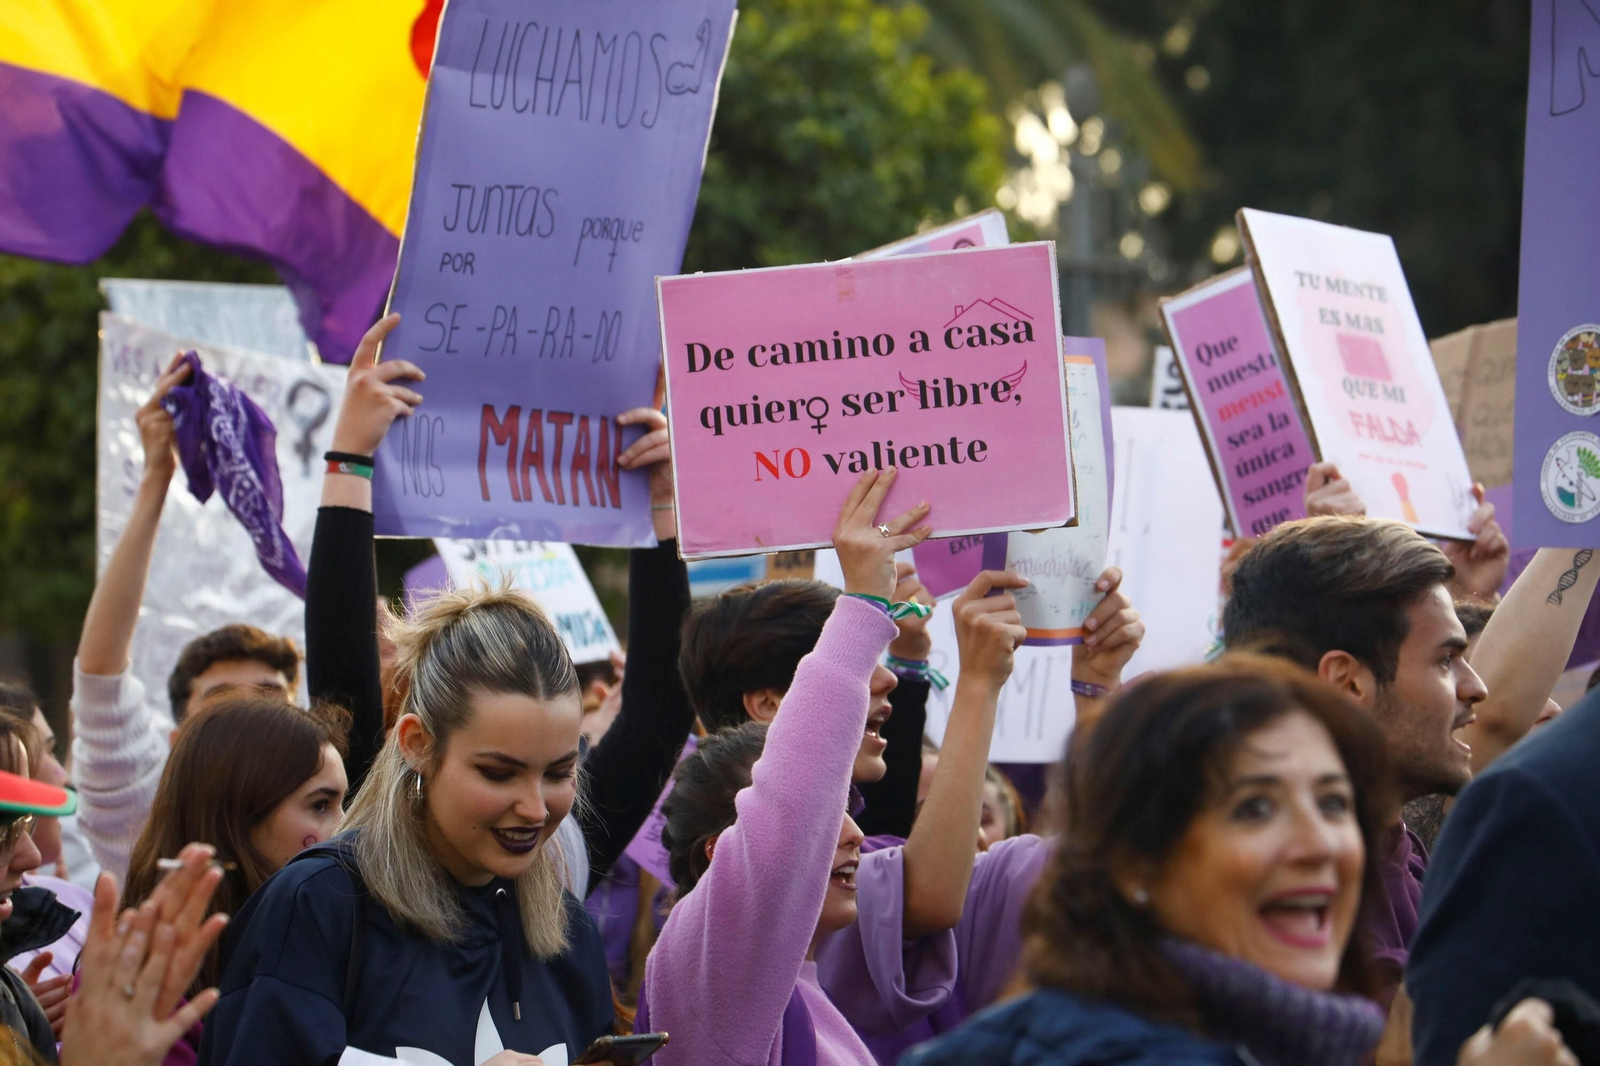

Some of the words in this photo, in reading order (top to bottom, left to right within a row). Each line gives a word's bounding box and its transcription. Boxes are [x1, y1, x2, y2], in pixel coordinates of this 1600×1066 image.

[469, 19, 667, 129] LUCHAMOS
[439, 252, 475, 275] POR
[1295, 270, 1320, 289] TU
[1325, 275, 1388, 303] MENTE
[1319, 307, 1340, 326] ES
[685, 341, 735, 374] De
[747, 330, 895, 368] camino
[909, 329, 932, 353] a
[944, 320, 1036, 351] casa
[1195, 336, 1239, 367] Que
[1207, 353, 1277, 393] nuestr
[1342, 377, 1379, 400] QUE
[1382, 384, 1406, 404] MI
[841, 388, 905, 418] ser
[918, 376, 1022, 410] libre,
[1218, 379, 1284, 422] menst
[1227, 423, 1264, 450] sea
[1268, 413, 1290, 432] la
[1347, 409, 1424, 448] FALDA
[400, 414, 445, 498] NOS
[478, 404, 623, 509] MATAN
[754, 447, 811, 482] NO
[822, 437, 988, 475] valiente
[1252, 507, 1290, 536] que
[949, 533, 984, 555] EXTR
